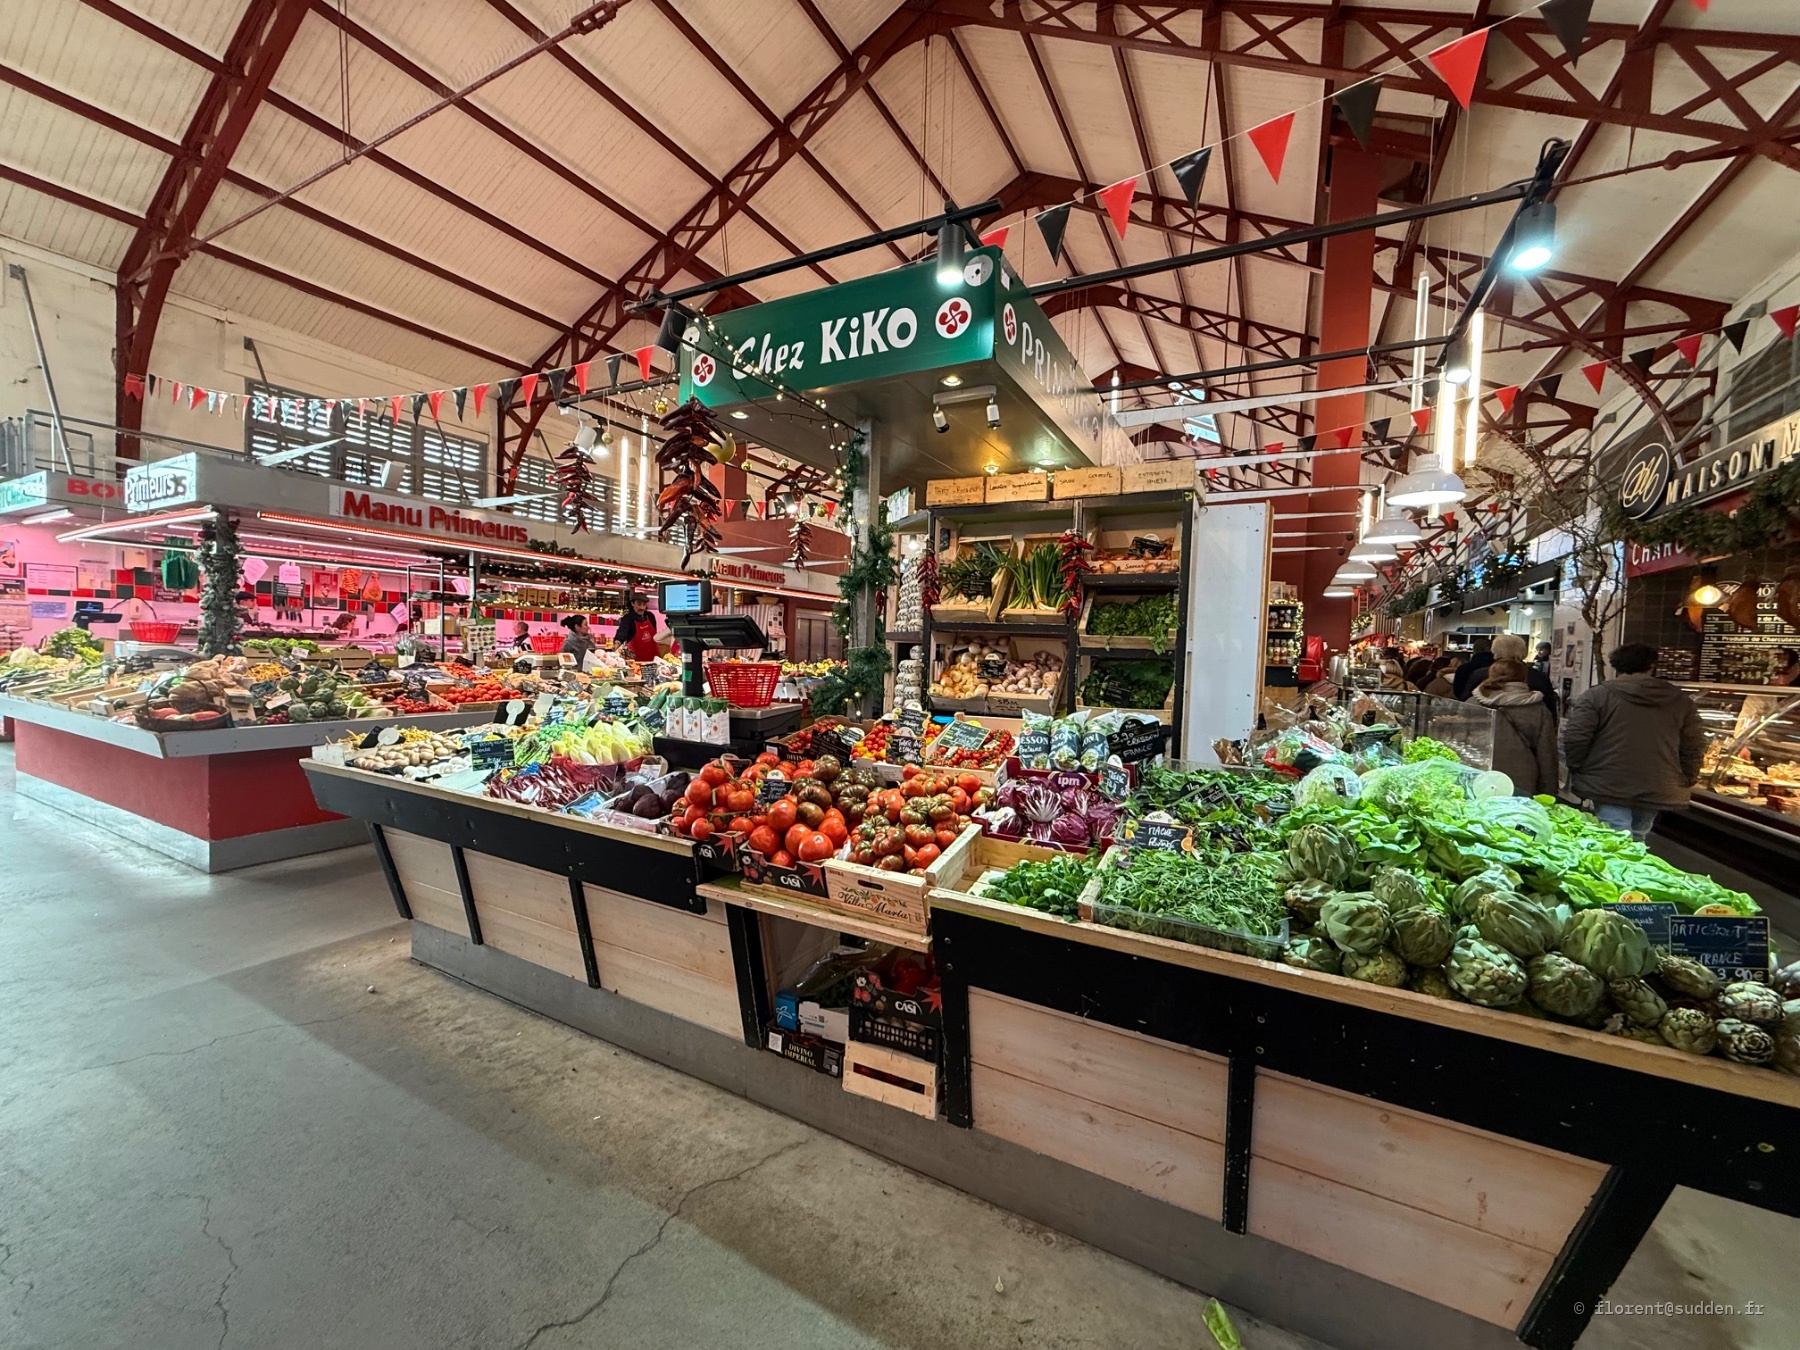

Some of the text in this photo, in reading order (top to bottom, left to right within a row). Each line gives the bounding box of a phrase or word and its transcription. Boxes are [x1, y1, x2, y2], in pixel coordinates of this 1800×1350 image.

[732, 307, 918, 380] Chez KiKO
[1666, 439, 1764, 506] MAISON
[67, 478, 123, 499] BO
[124, 472, 176, 504] Primeurs
[343, 490, 528, 543] Manu Primeurs
[711, 558, 786, 585] Manu Primeurs
[1123, 743, 1153, 757] FRANCE
[1058, 774, 1080, 787] ipm
[780, 875, 801, 888] CASI
[895, 1001, 917, 1015] CASI
[783, 1049, 817, 1067] IMPERIAL
[788, 1043, 814, 1058] DIVINO
